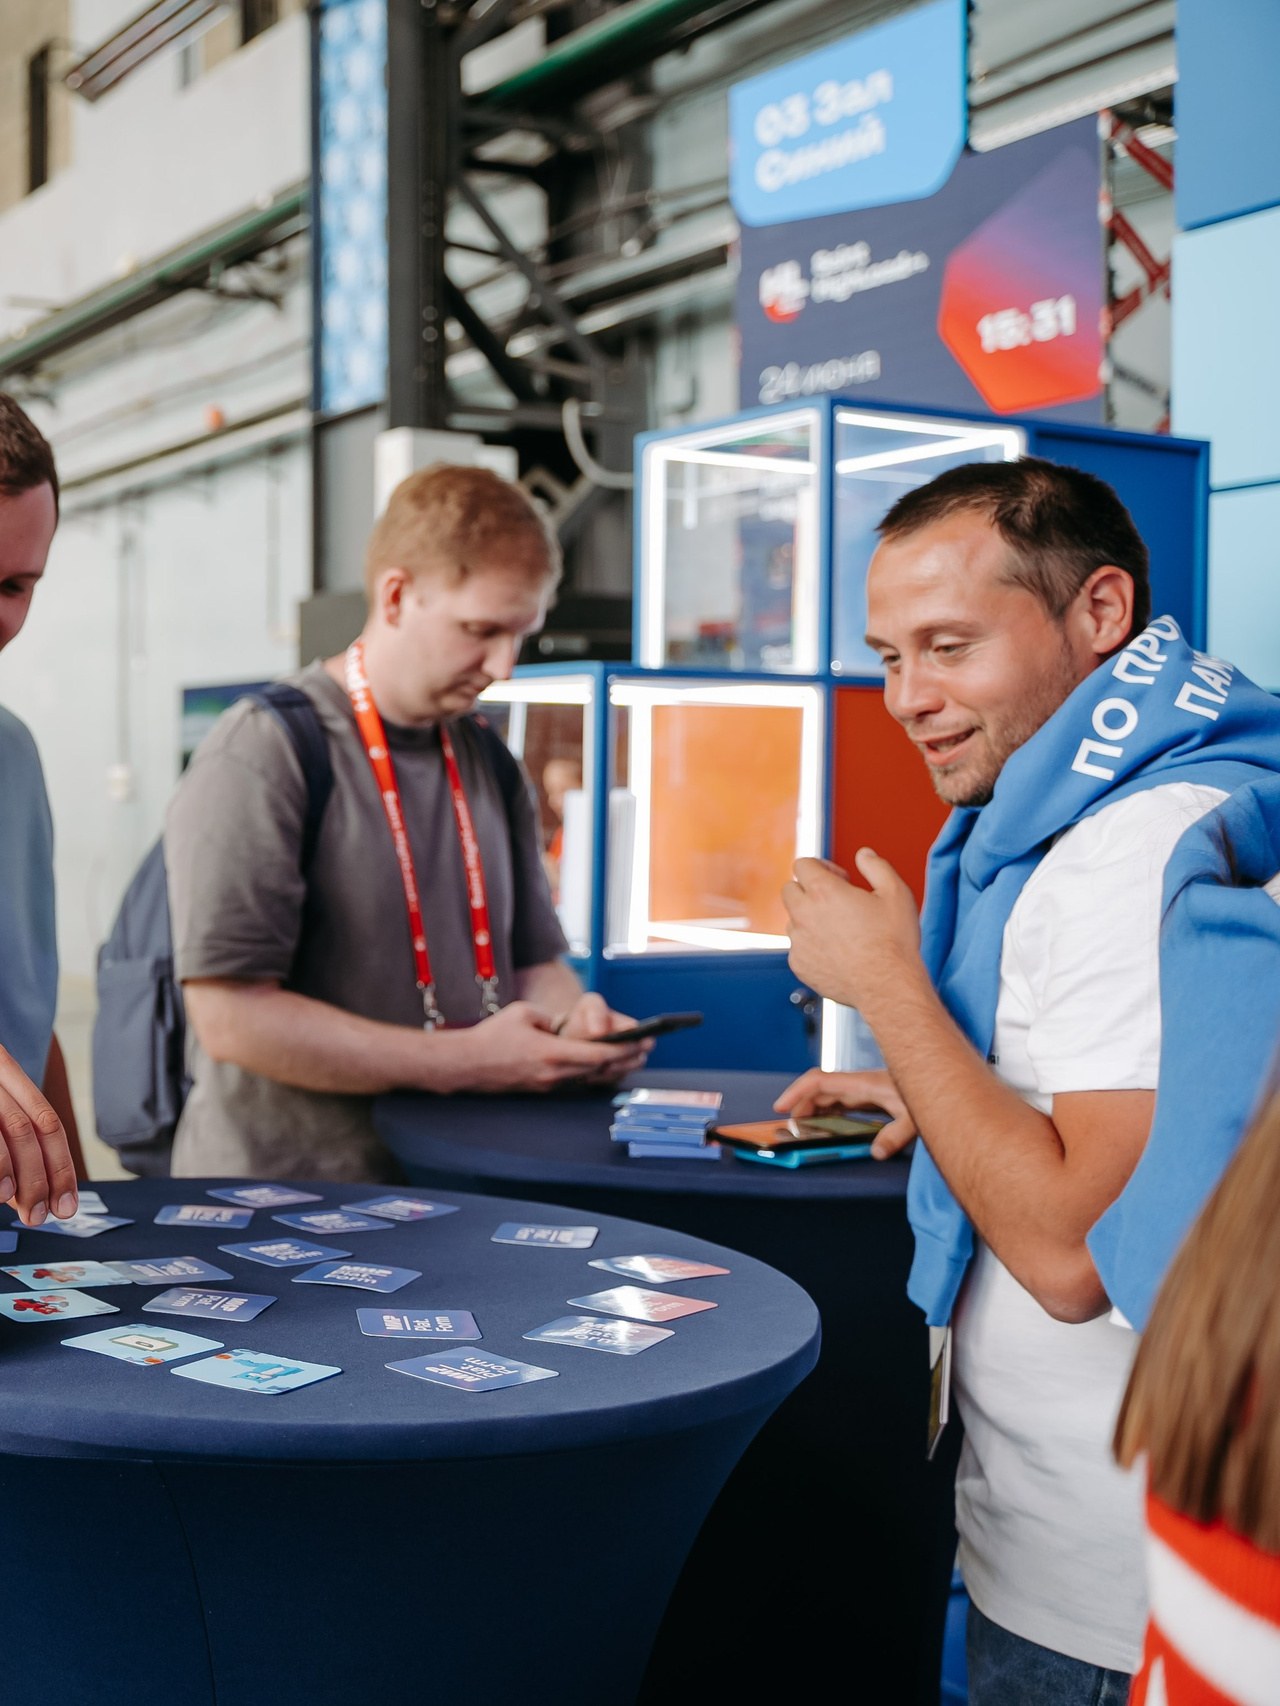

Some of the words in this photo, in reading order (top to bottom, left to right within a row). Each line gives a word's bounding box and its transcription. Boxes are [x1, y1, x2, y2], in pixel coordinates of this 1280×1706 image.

[755, 92, 811, 147] 03
[813, 68, 894, 126] Зал
[1071, 697, 1139, 781] ПО
[1111, 615, 1180, 685] ПРО
